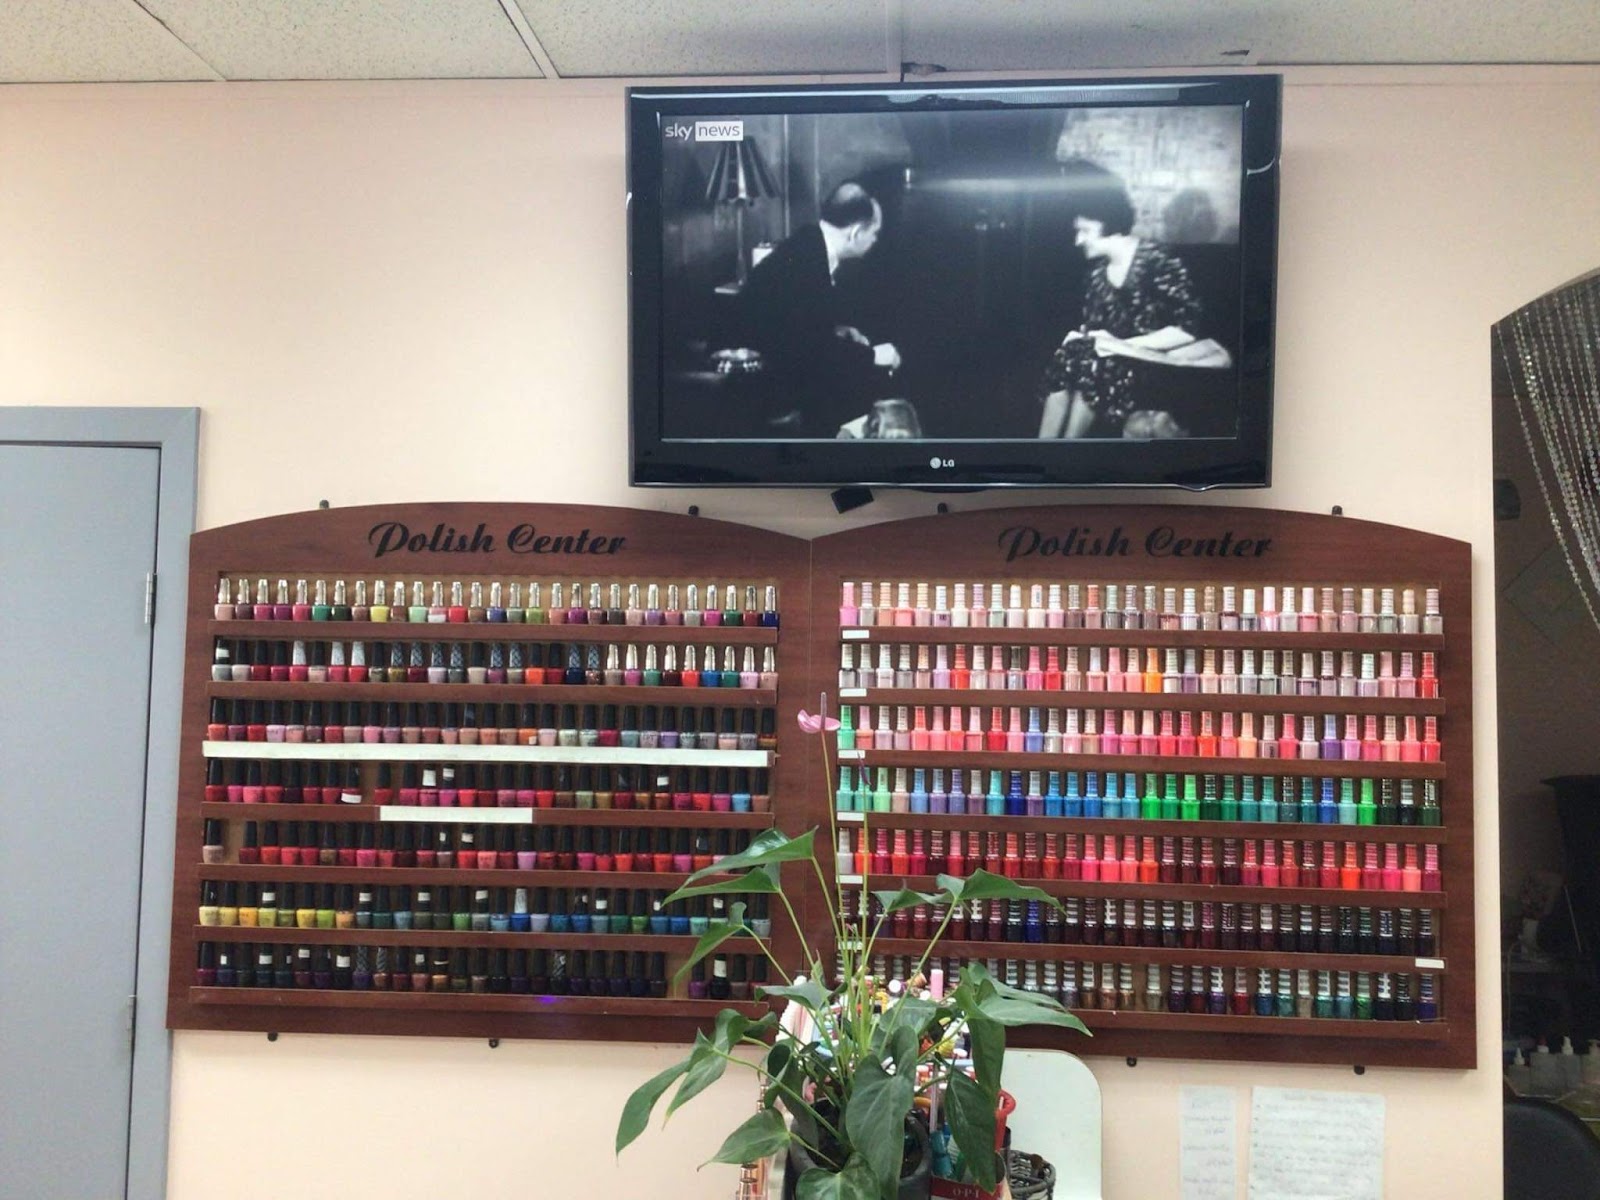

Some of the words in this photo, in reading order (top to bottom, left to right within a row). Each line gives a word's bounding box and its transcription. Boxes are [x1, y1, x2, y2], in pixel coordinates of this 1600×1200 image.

[664, 122, 694, 141] sky
[698, 125, 741, 138] news
[368, 522, 497, 559] Polish
[506, 523, 627, 555] Center
[998, 526, 1132, 562] Polish
[1144, 526, 1273, 558] Center
